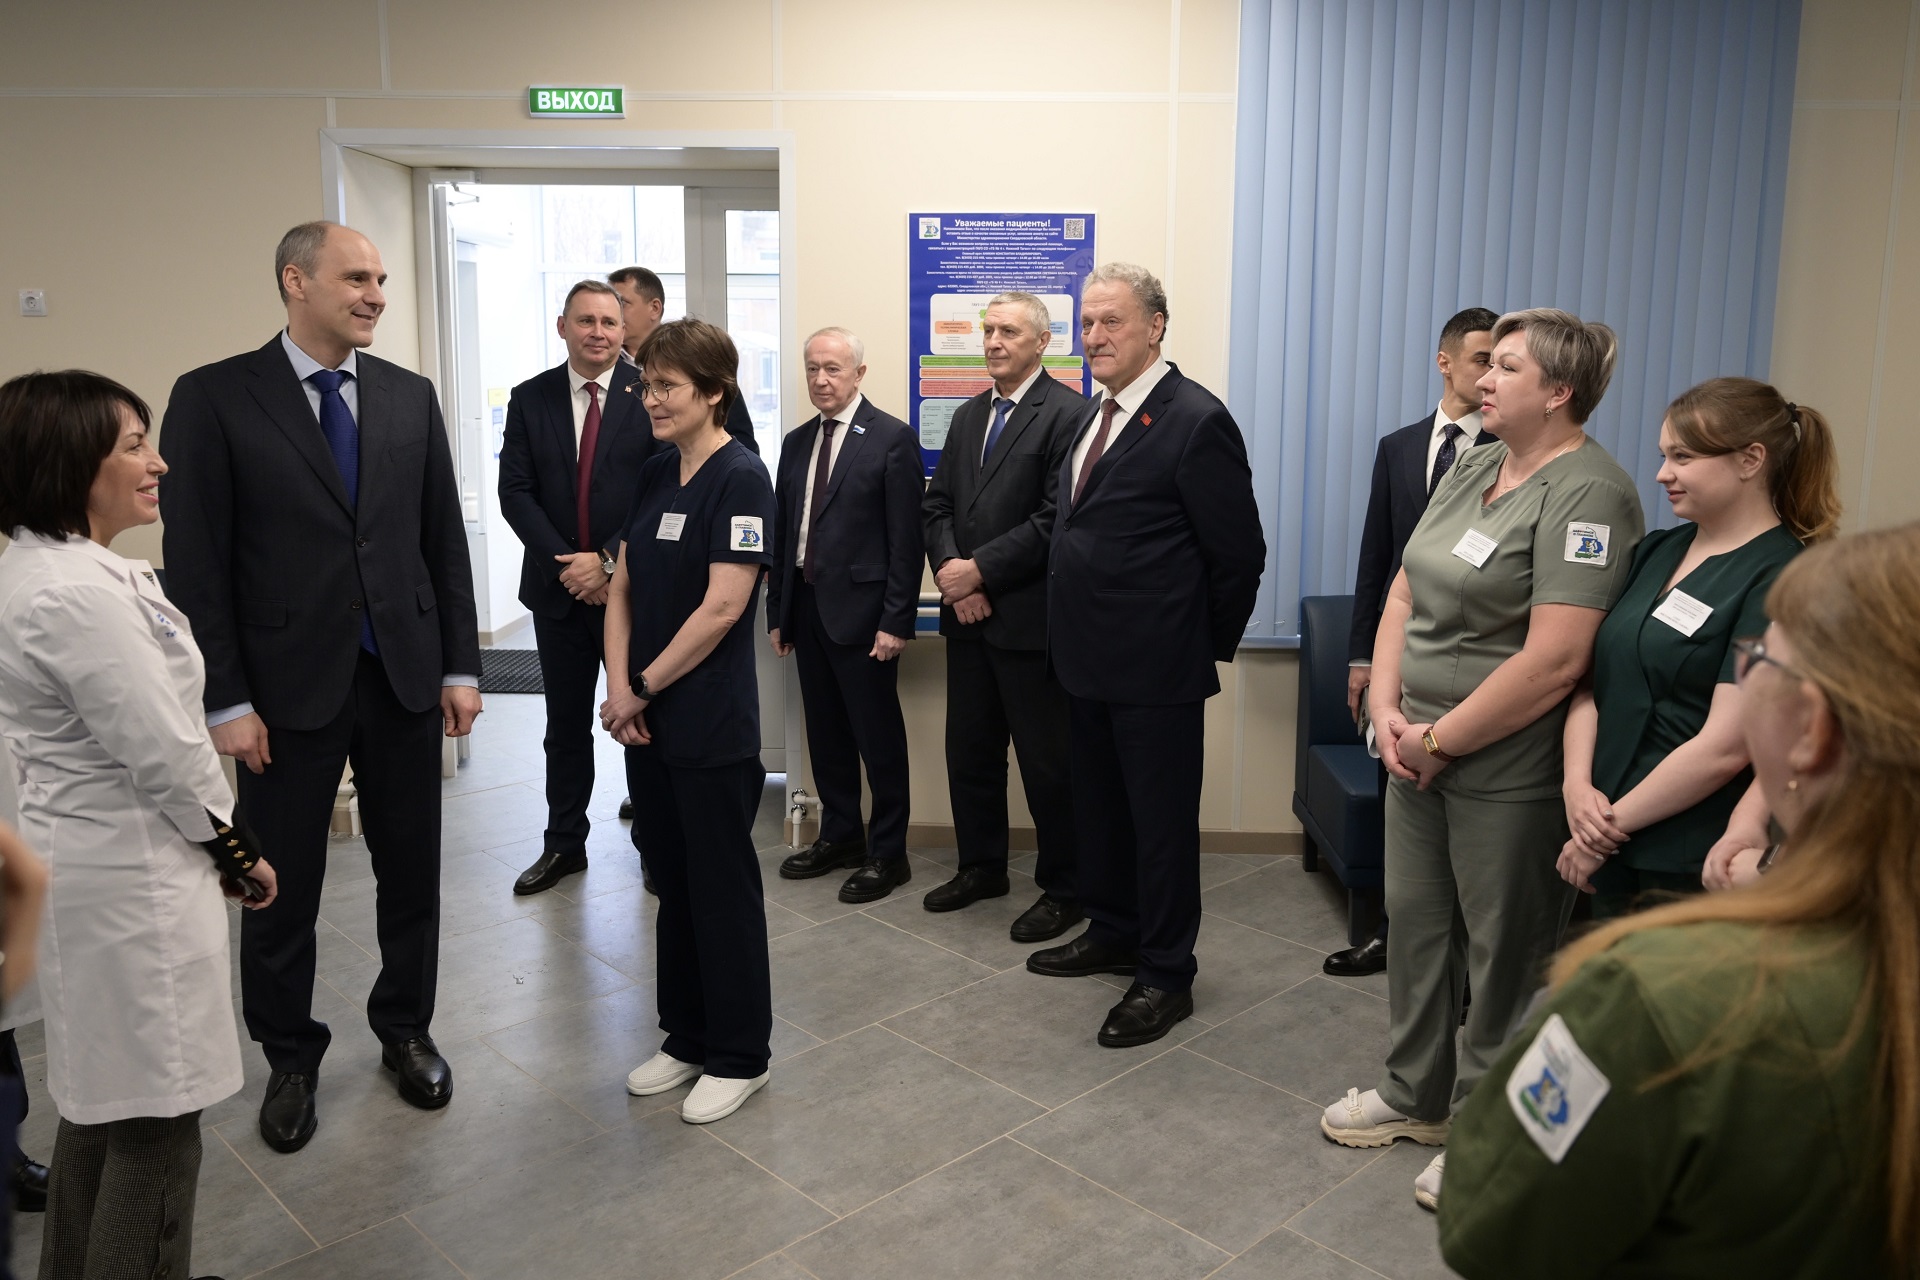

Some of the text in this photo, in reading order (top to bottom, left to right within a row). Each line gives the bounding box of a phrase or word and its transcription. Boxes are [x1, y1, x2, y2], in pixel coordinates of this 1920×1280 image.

[537, 91, 615, 111] ВЫХОД
[954, 219, 1005, 227] Уважаемые
[1006, 219, 1051, 229] пациенты!
